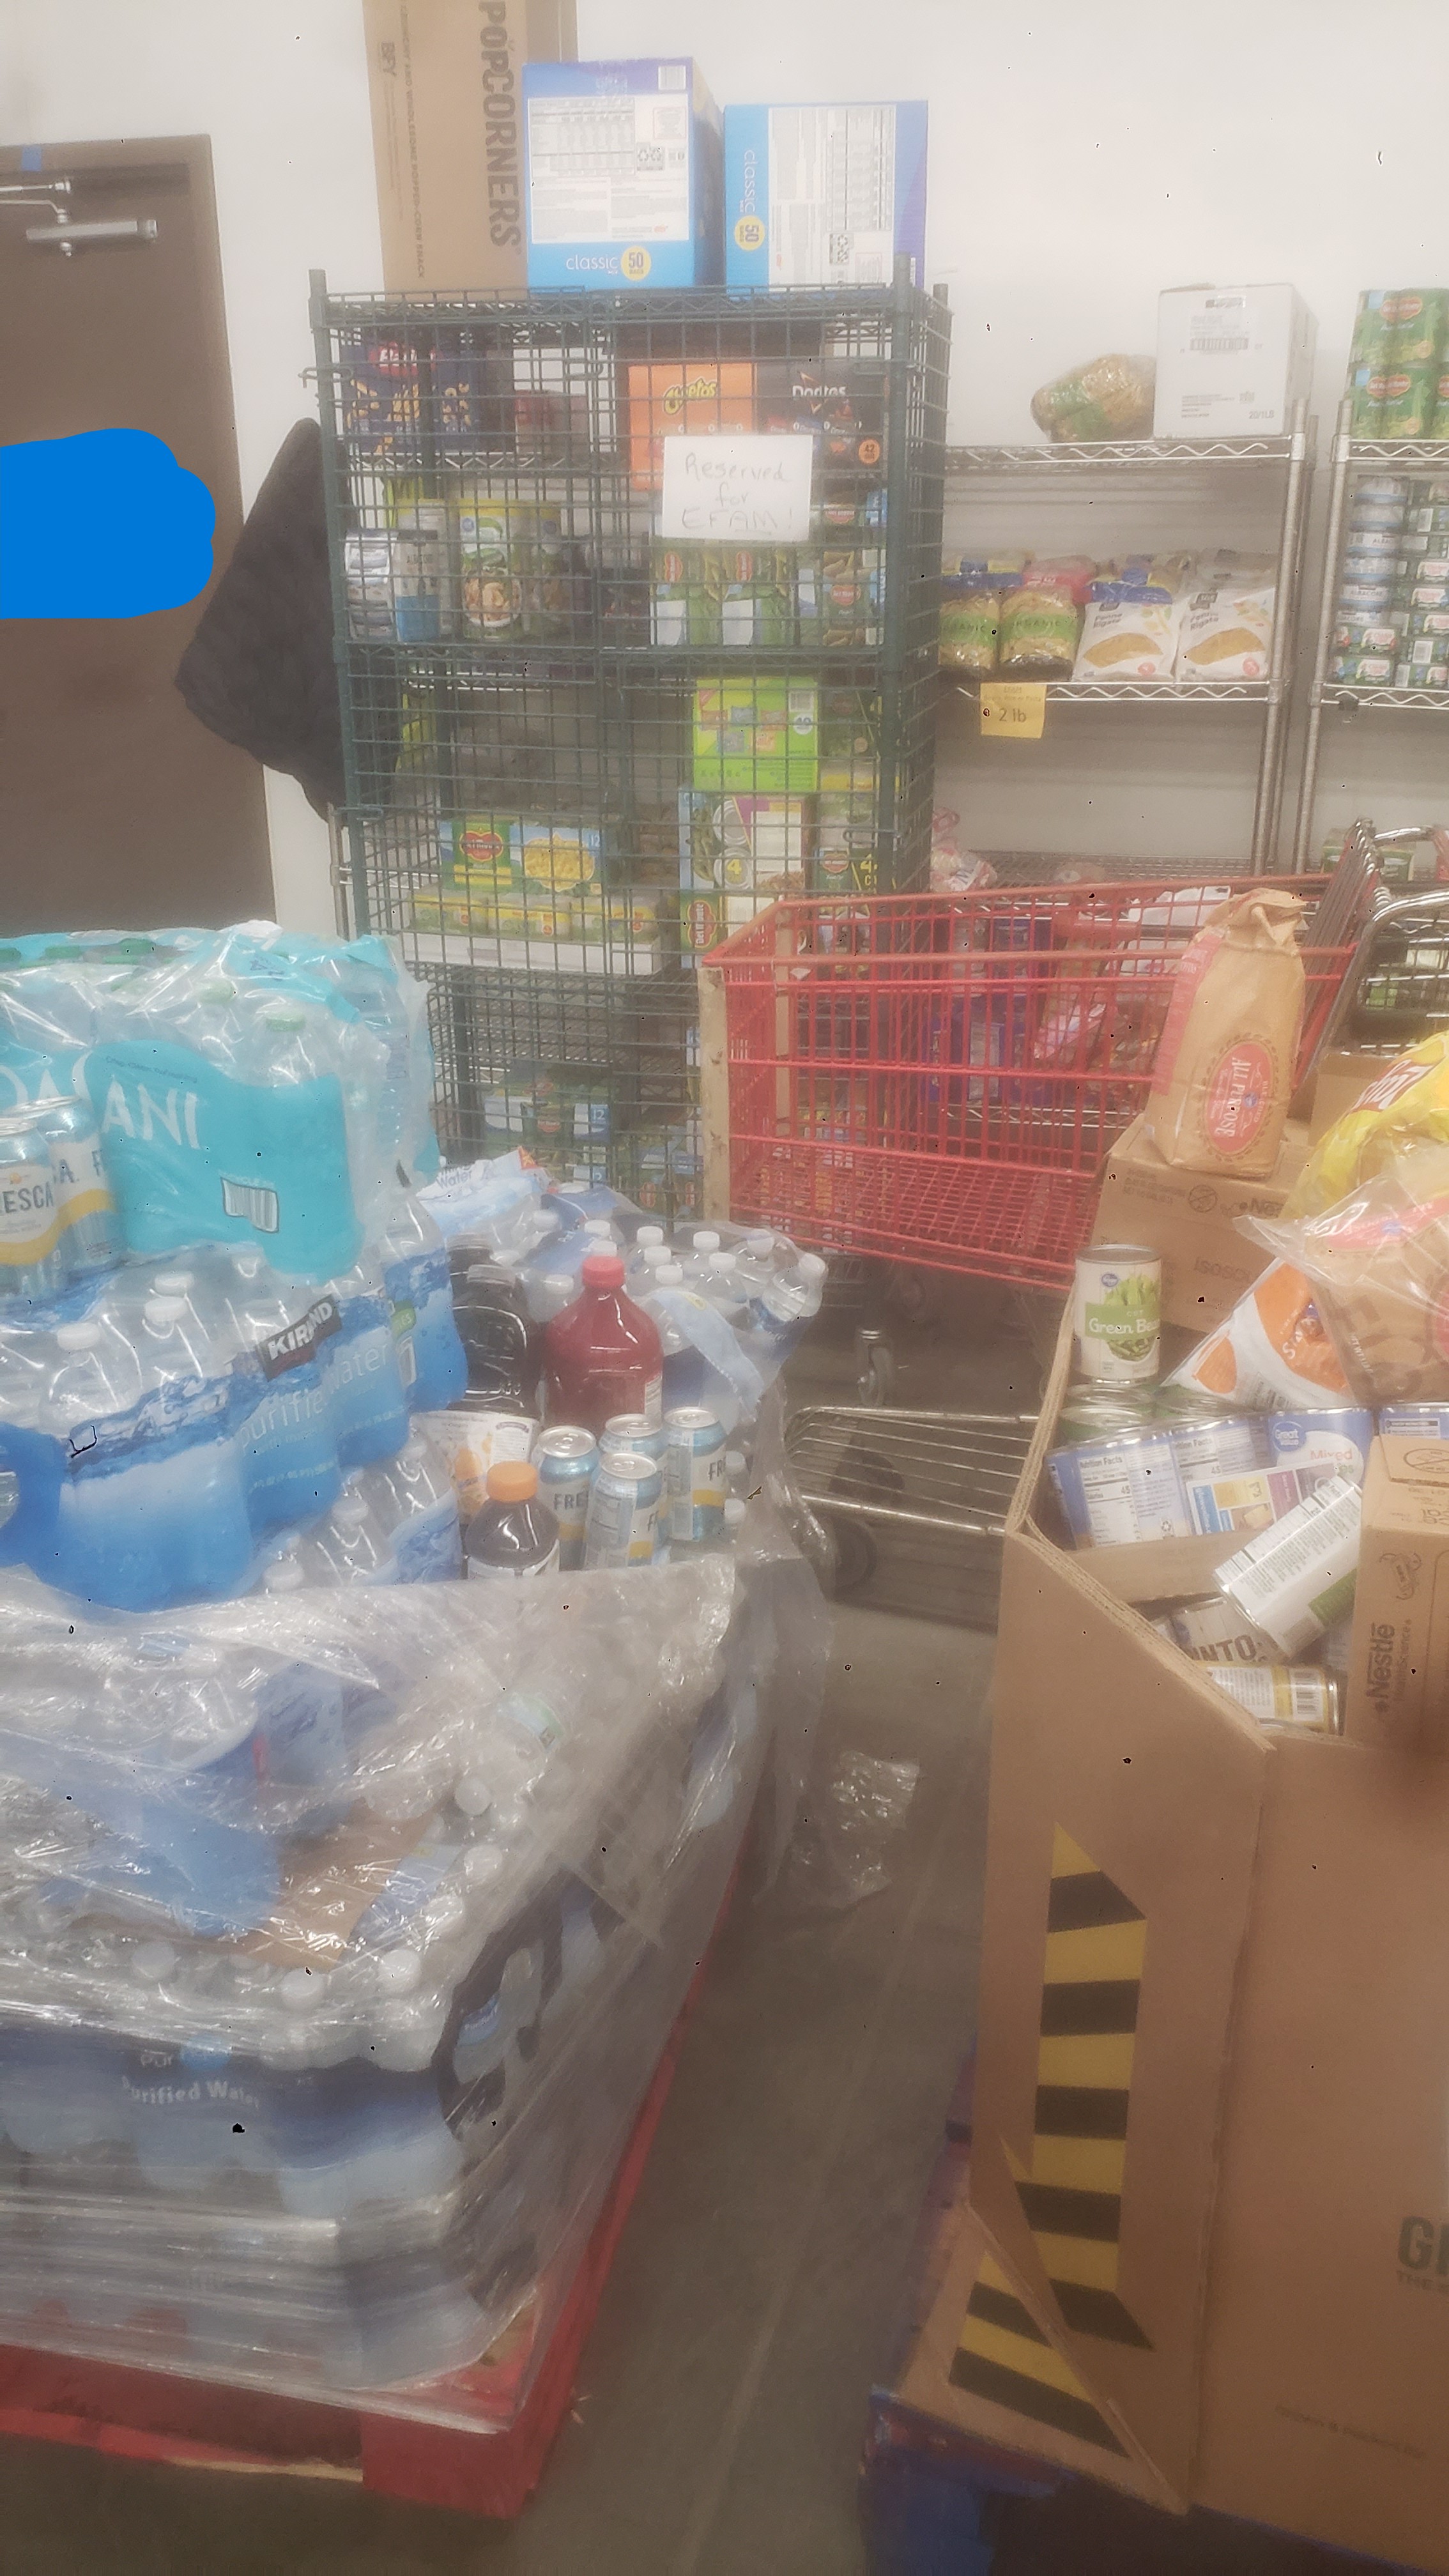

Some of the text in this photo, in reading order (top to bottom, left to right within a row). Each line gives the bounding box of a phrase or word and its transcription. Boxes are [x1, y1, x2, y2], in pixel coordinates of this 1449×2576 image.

[477, 1, 521, 248] POPCORNERS
[744, 149, 762, 213] classic
[745, 224, 760, 243] 50
[565, 255, 618, 270] classic
[628, 252, 643, 268] 50
[686, 452, 792, 483] Reserved
[716, 482, 749, 507] for
[999, 708, 1027, 723] 2 lb
[727, 859, 742, 875] 4
[1231, 1056, 1252, 1082] ALL
[593, 1109, 605, 1121] 12
[1216, 1084, 1246, 1139] PURPOSE
[436, 1169, 473, 1190] Water
[0, 1182, 53, 1214] ESCA
[1089, 1318, 1133, 1334] Green
[1275, 1429, 1298, 1439] Great
[1103, 1455, 1123, 1465] Facts
[1310, 1448, 1353, 1460] Mixed
[1120, 1485, 1131, 1495] 45
